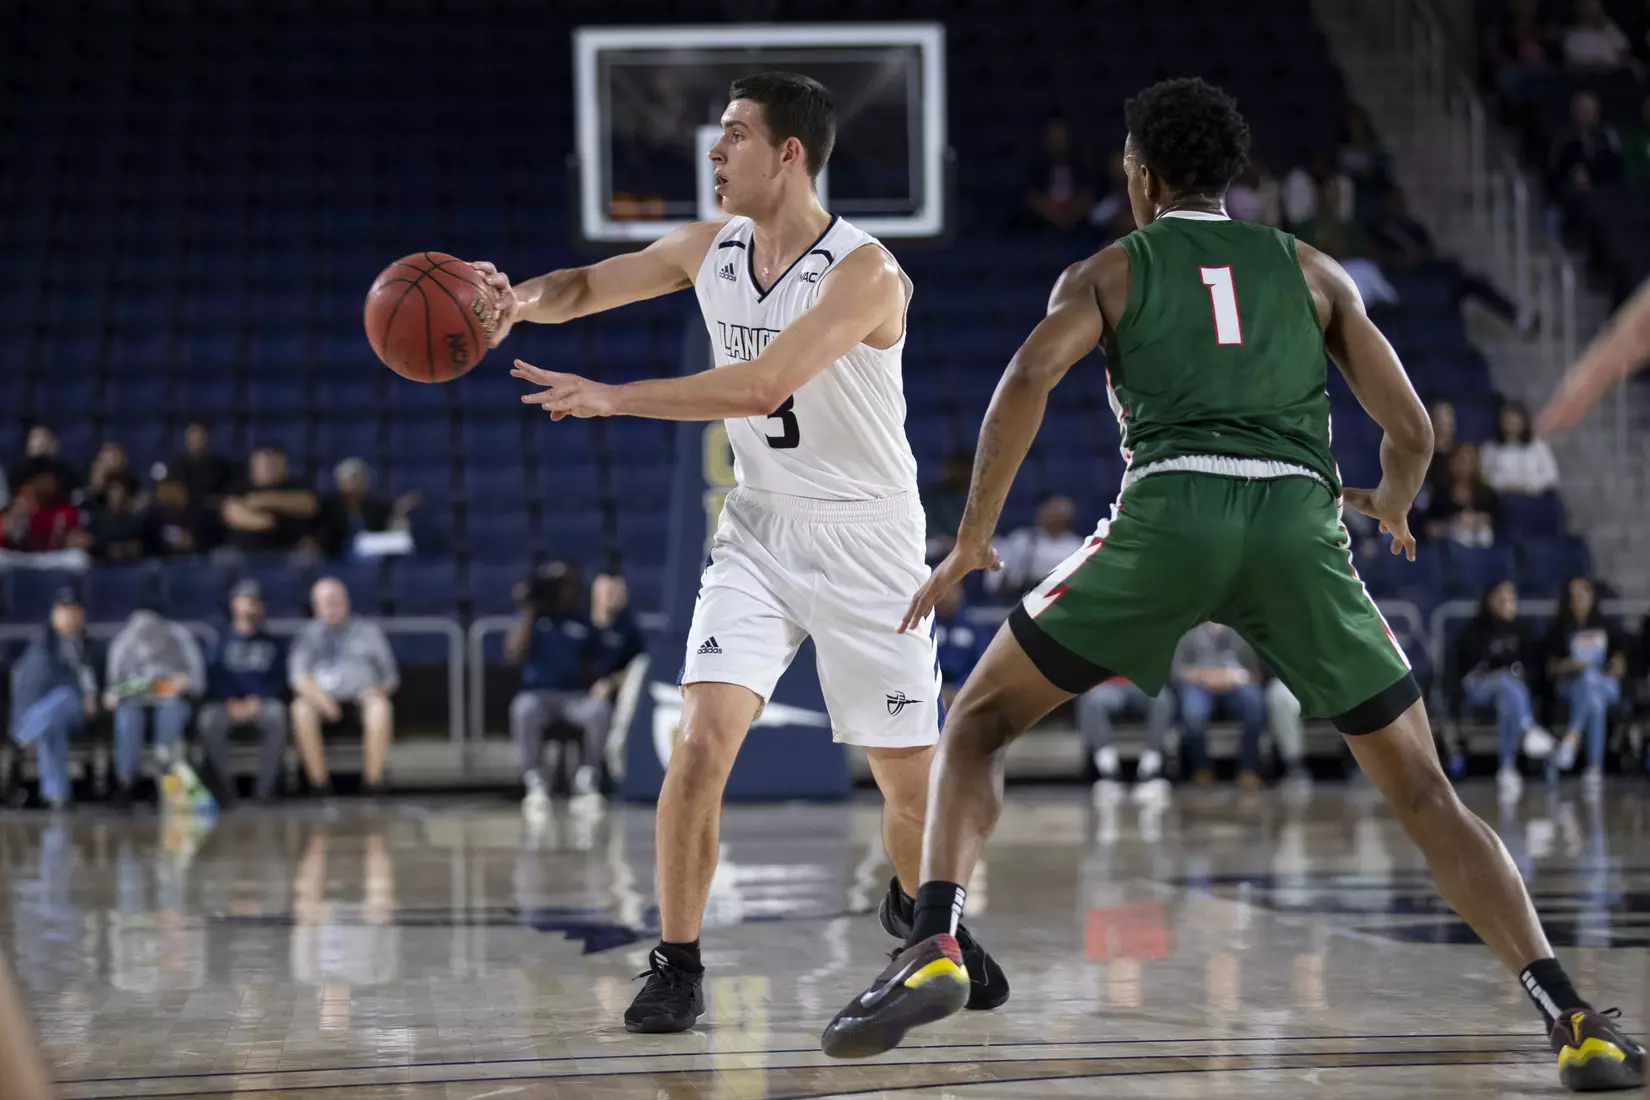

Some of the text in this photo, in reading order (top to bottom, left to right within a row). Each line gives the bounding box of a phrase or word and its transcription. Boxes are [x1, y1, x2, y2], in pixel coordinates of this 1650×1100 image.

[1199, 264, 1244, 345] 1
[717, 320, 781, 361] LANC
[765, 393, 800, 449] 3
[697, 646, 722, 655] adidas
